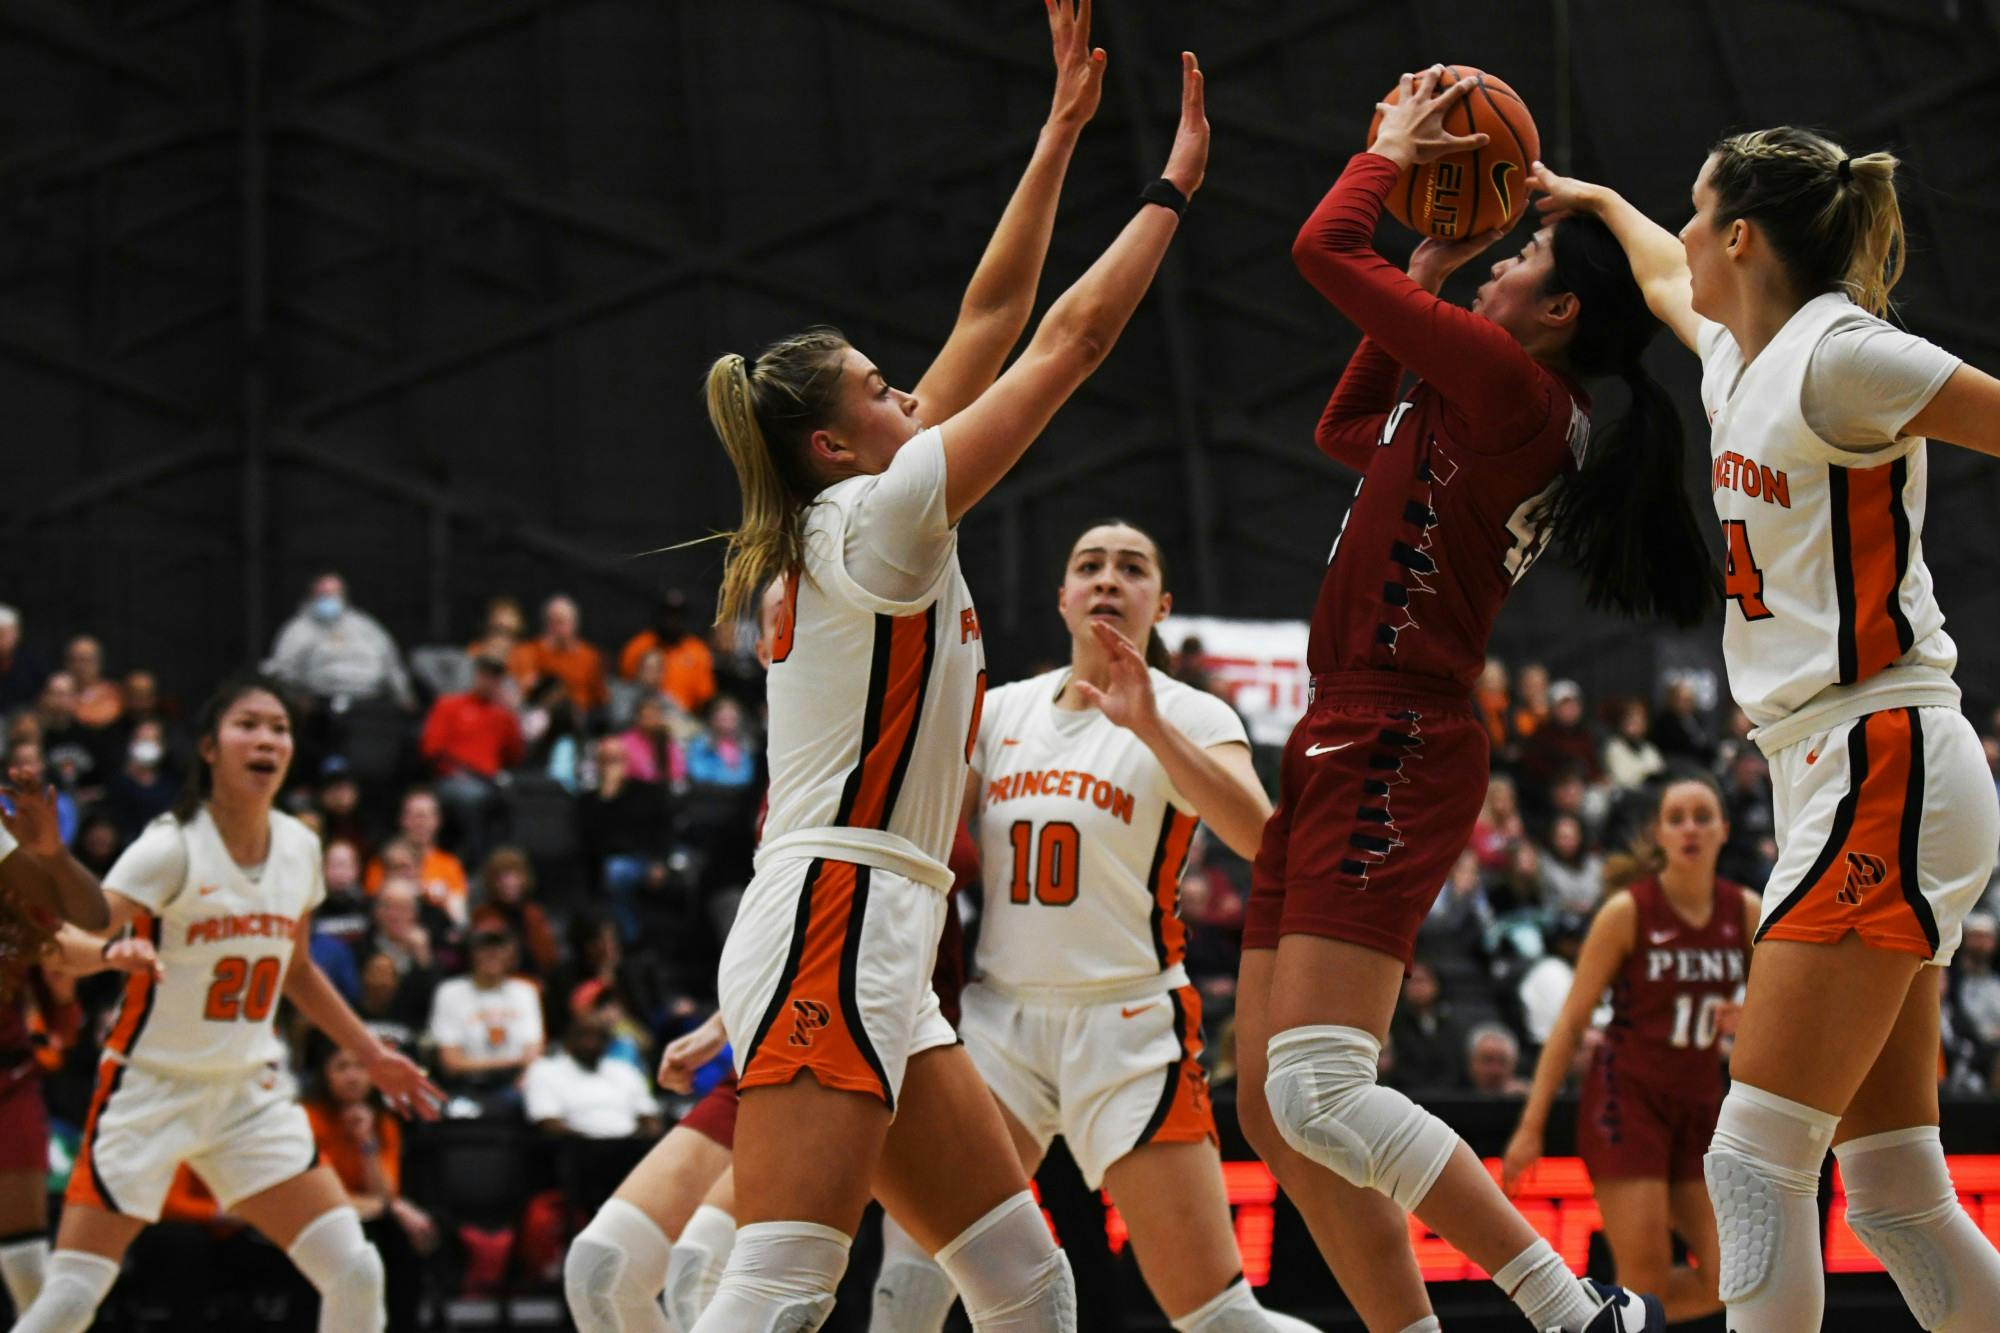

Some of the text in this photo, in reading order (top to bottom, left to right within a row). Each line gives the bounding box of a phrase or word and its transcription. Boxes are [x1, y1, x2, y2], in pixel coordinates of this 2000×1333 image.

[1721, 519, 1775, 621] 4
[985, 769, 1135, 826] PRINCETON
[1010, 820, 1080, 906] 10
[1836, 852, 1886, 906] P
[185, 914, 298, 946] PRINCETO
[204, 957, 280, 1021] 20
[1647, 949, 1744, 982] PENN
[788, 999, 831, 1047] P
